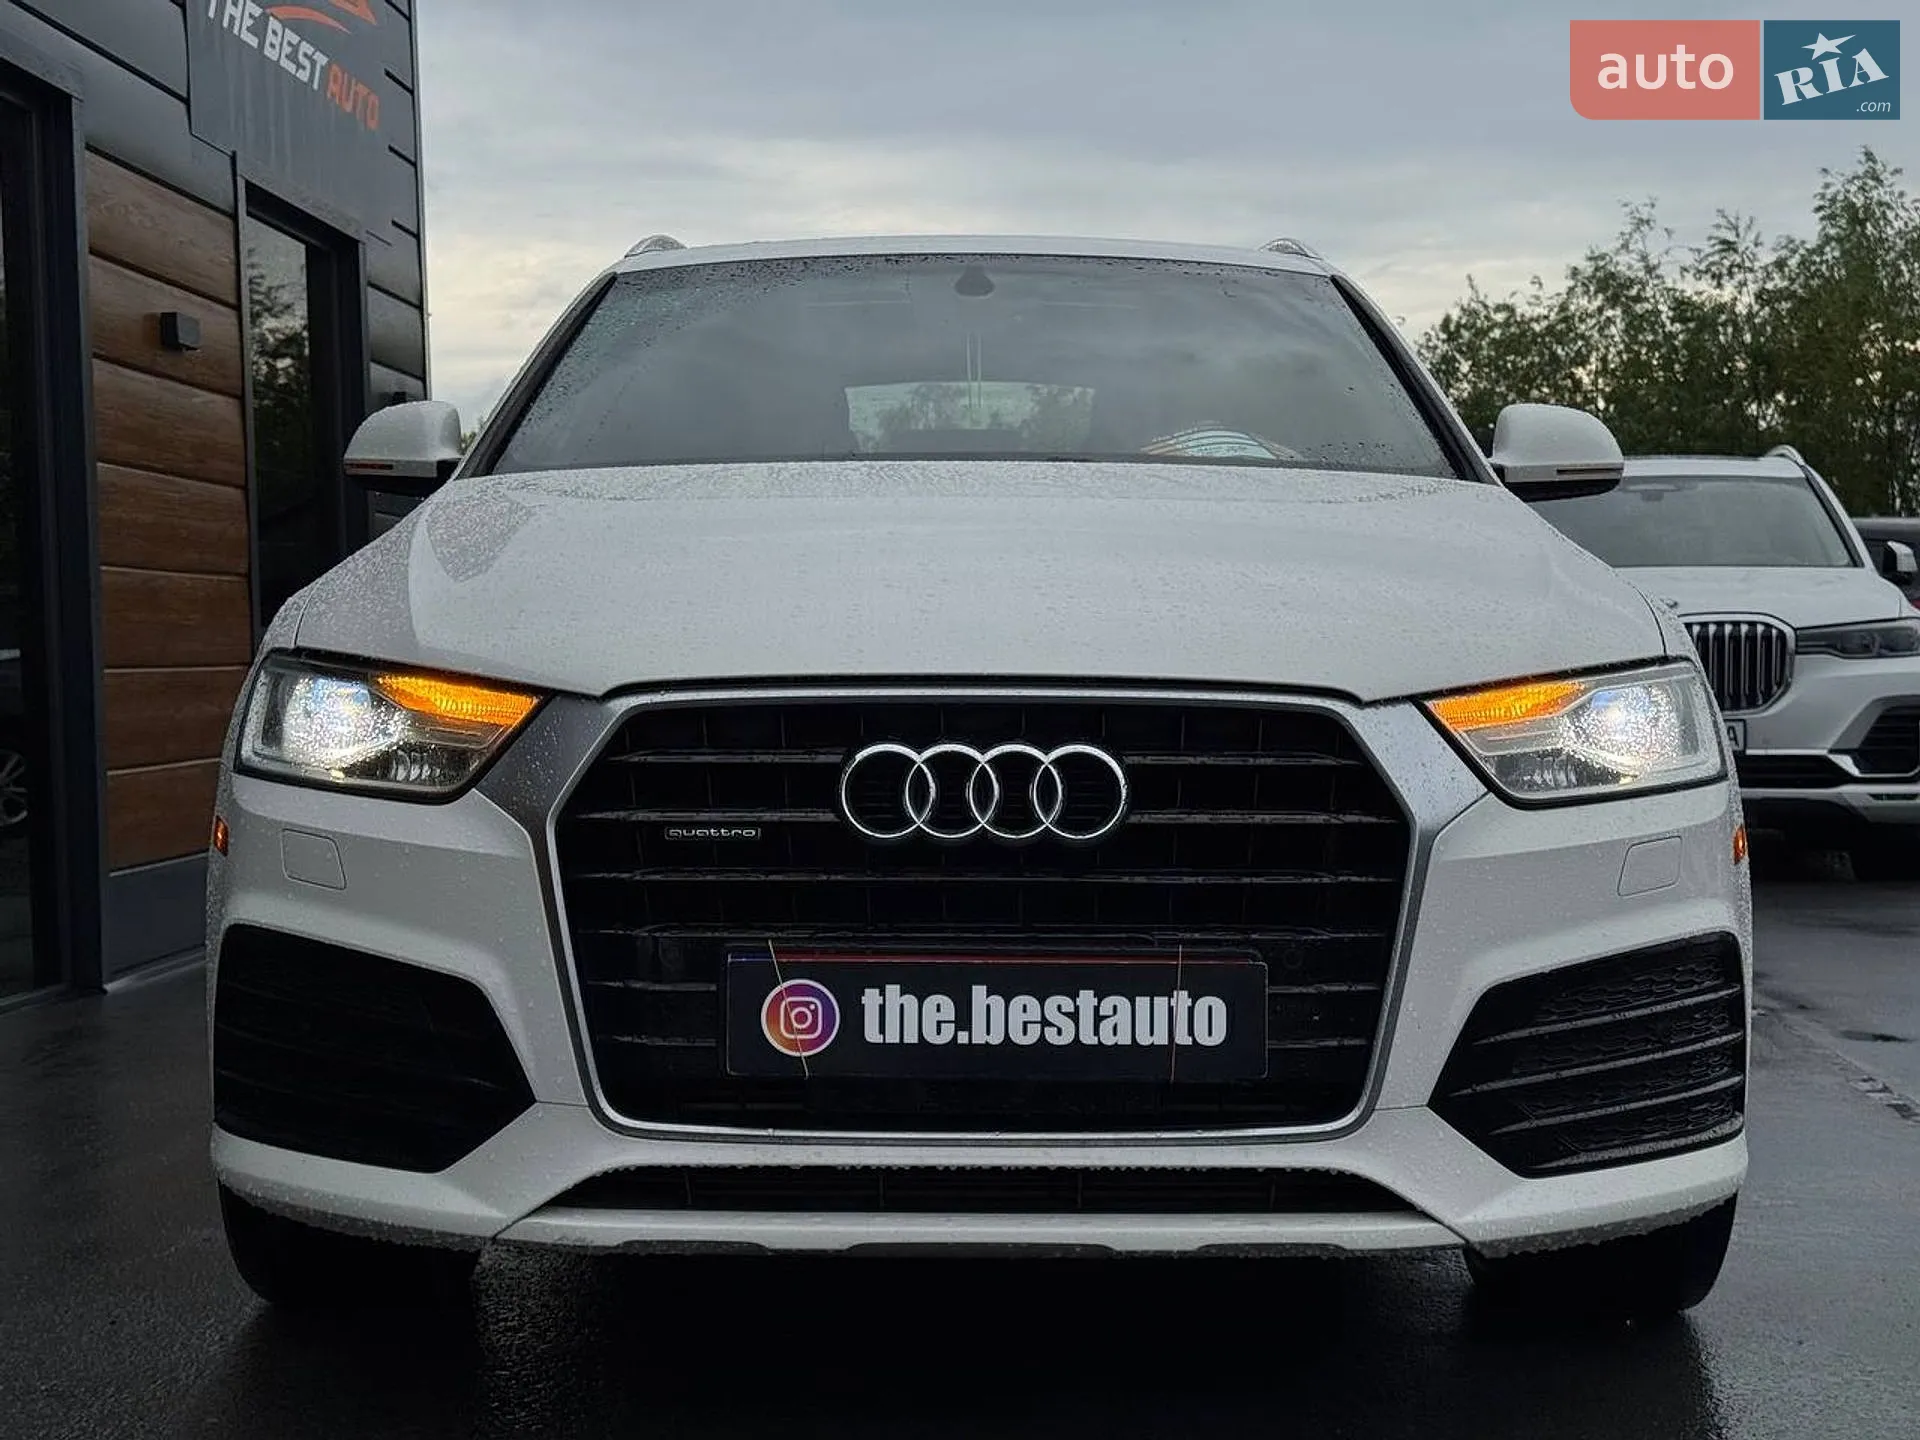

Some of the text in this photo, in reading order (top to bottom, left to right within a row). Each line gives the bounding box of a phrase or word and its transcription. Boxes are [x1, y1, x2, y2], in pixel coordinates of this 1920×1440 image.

[263, 15, 330, 91] BEST
[326, 63, 380, 131] AUTO
[668, 828, 757, 839] quattro
[861, 984, 1228, 1046] the.bestauto
